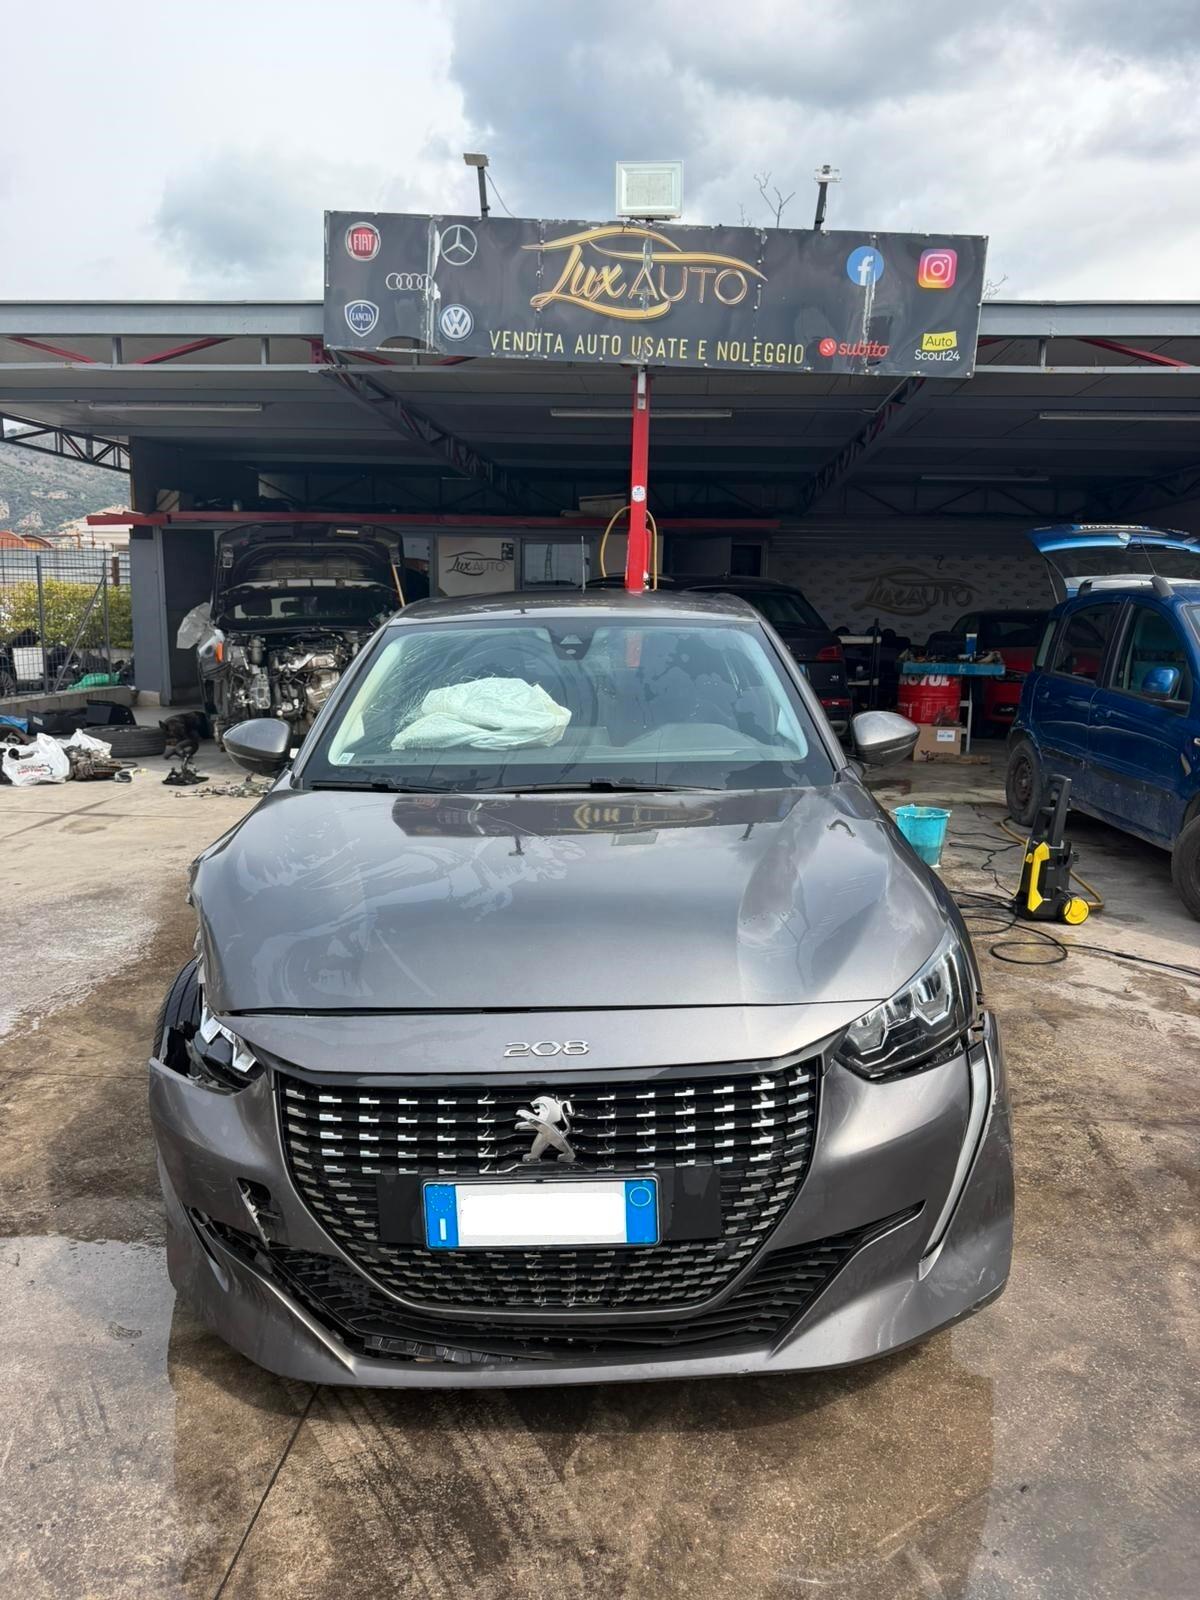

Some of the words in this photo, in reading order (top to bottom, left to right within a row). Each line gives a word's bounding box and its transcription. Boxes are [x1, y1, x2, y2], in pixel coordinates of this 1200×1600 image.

[353, 234, 375, 251] FIAT
[351, 312, 372, 322] LANCIA
[490, 330, 565, 354] VENDITA
[574, 334, 622, 356] AUTO
[631, 335, 689, 359] USATE
[697, 340, 708, 360] E
[716, 341, 804, 364] NOLEGGIO
[838, 340, 890, 357] subito
[924, 336, 953, 347] Auto
[914, 350, 960, 361] Scout24
[503, 1040, 590, 1057] 208
